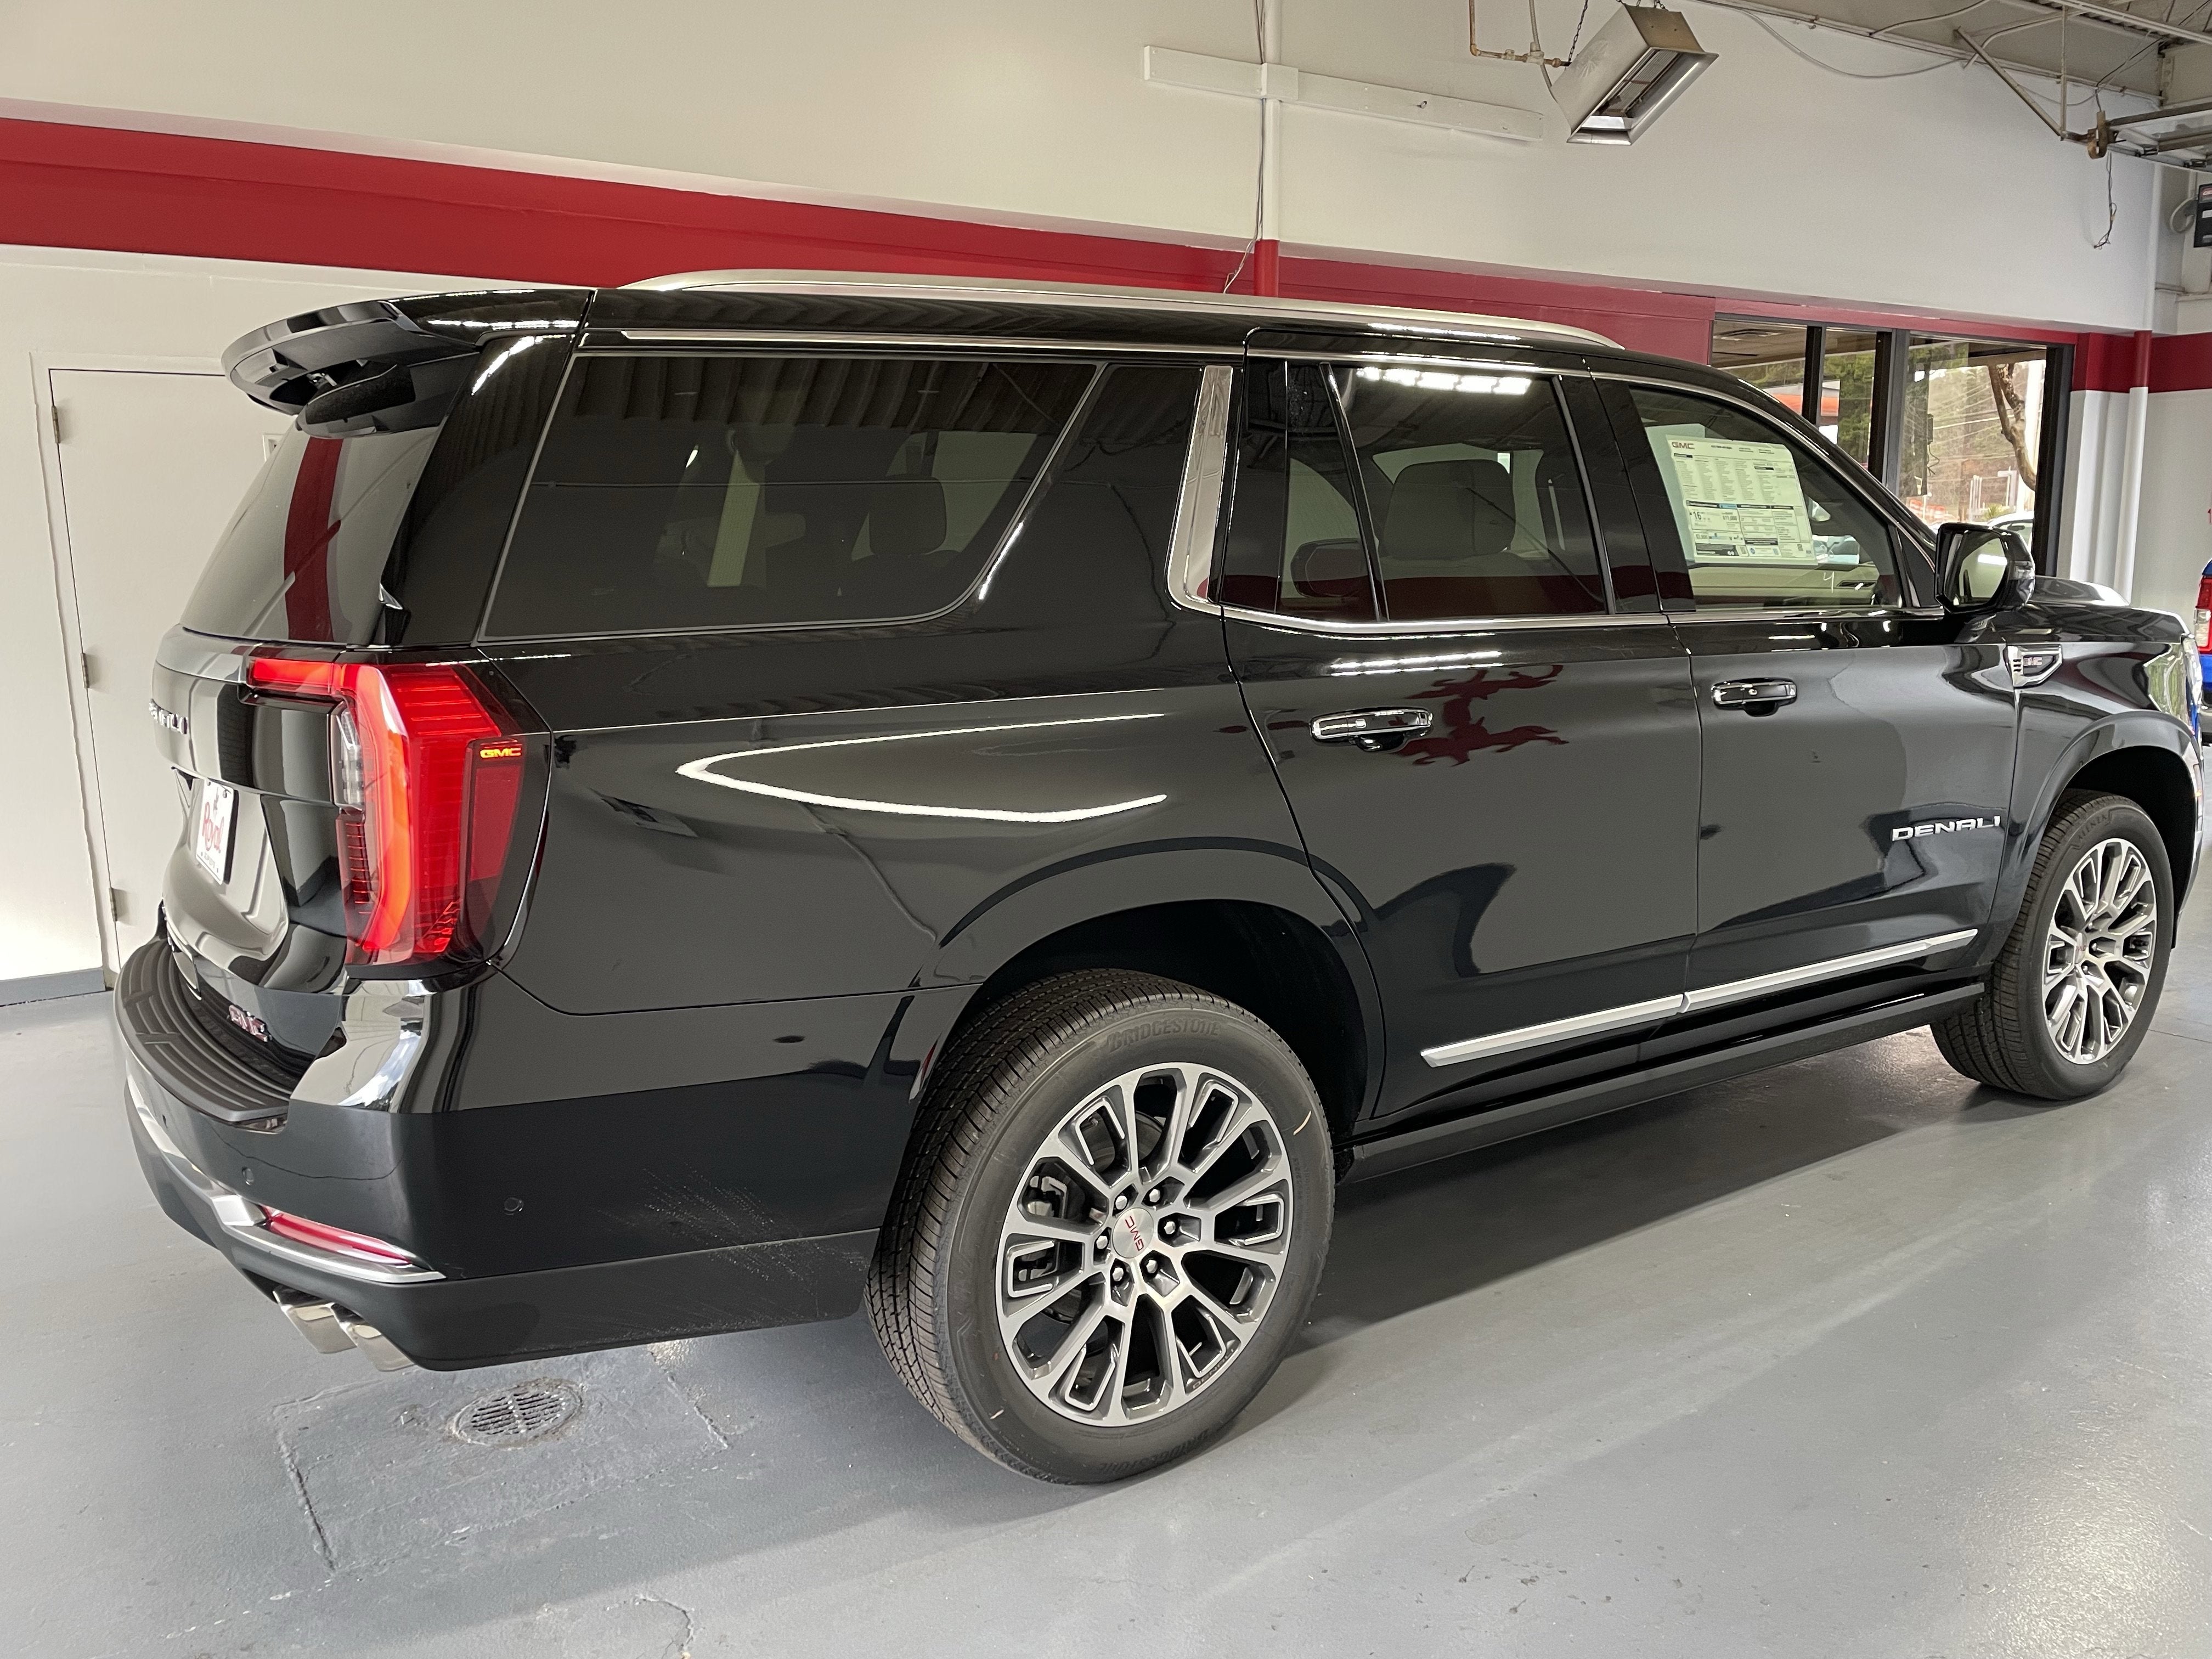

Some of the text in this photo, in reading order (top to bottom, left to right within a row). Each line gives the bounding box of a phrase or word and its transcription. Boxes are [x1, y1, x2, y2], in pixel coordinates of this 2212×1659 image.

[480, 747, 522, 759] GMC
[1892, 815, 2001, 842] DENALI
[229, 1005, 268, 1042] GMC
[1106, 1018, 1221, 1053] BRIDGESTONE
[1124, 1215, 1145, 1251] GMC
